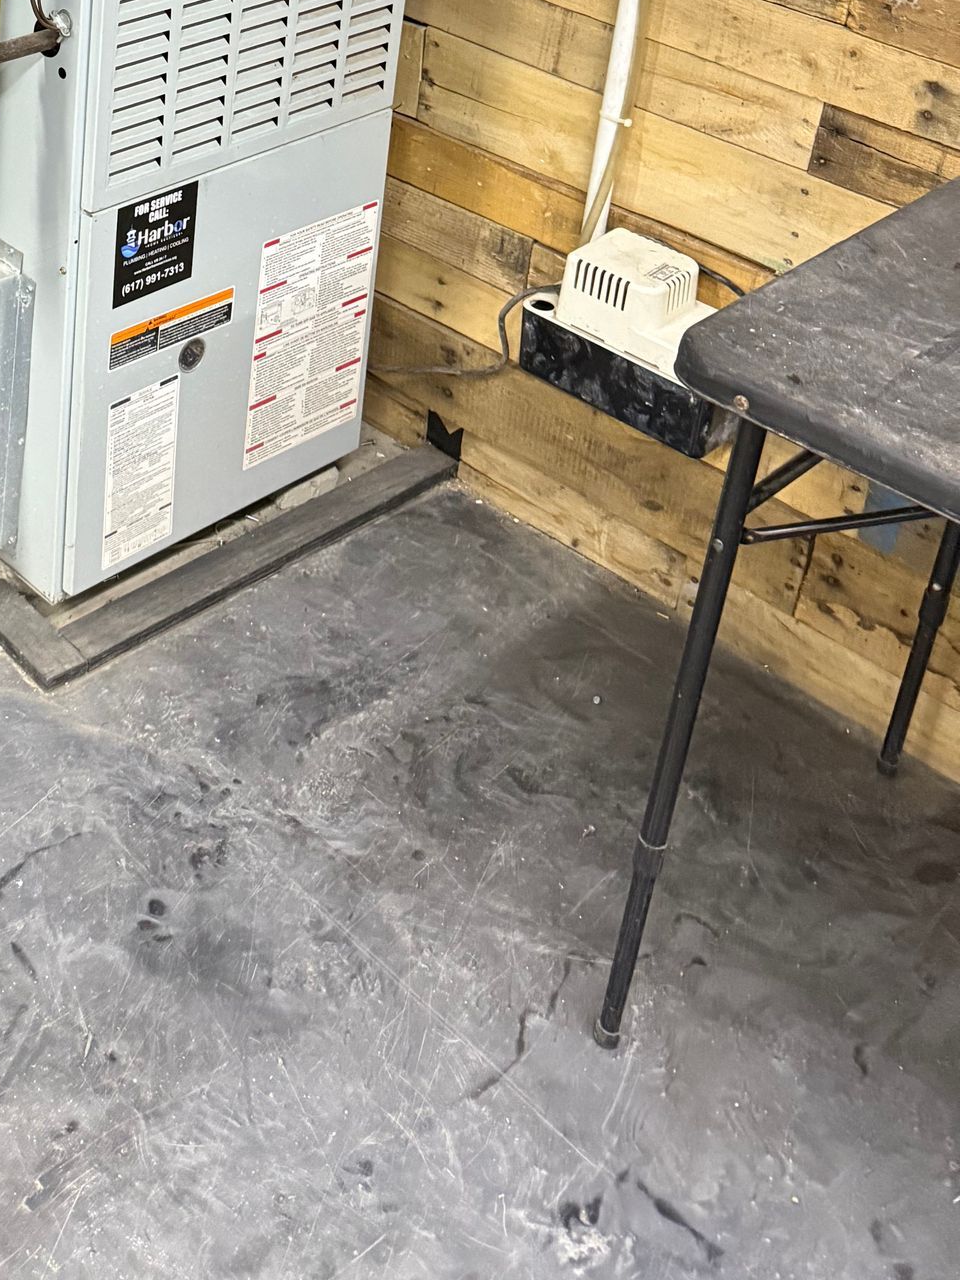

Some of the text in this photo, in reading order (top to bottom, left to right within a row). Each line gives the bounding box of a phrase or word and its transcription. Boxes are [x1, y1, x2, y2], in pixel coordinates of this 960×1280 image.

[134, 190, 183, 218] FOR SERVICE
[148, 208, 170, 223] CALL:
[138, 216, 191, 245] Harbor
[123, 253, 146, 267] PLUMBING
[149, 245, 167, 257] HEATING
[170, 236, 189, 249] COOLING
[121, 278, 144, 297] (617)
[145, 262, 185, 285] 991-7313
